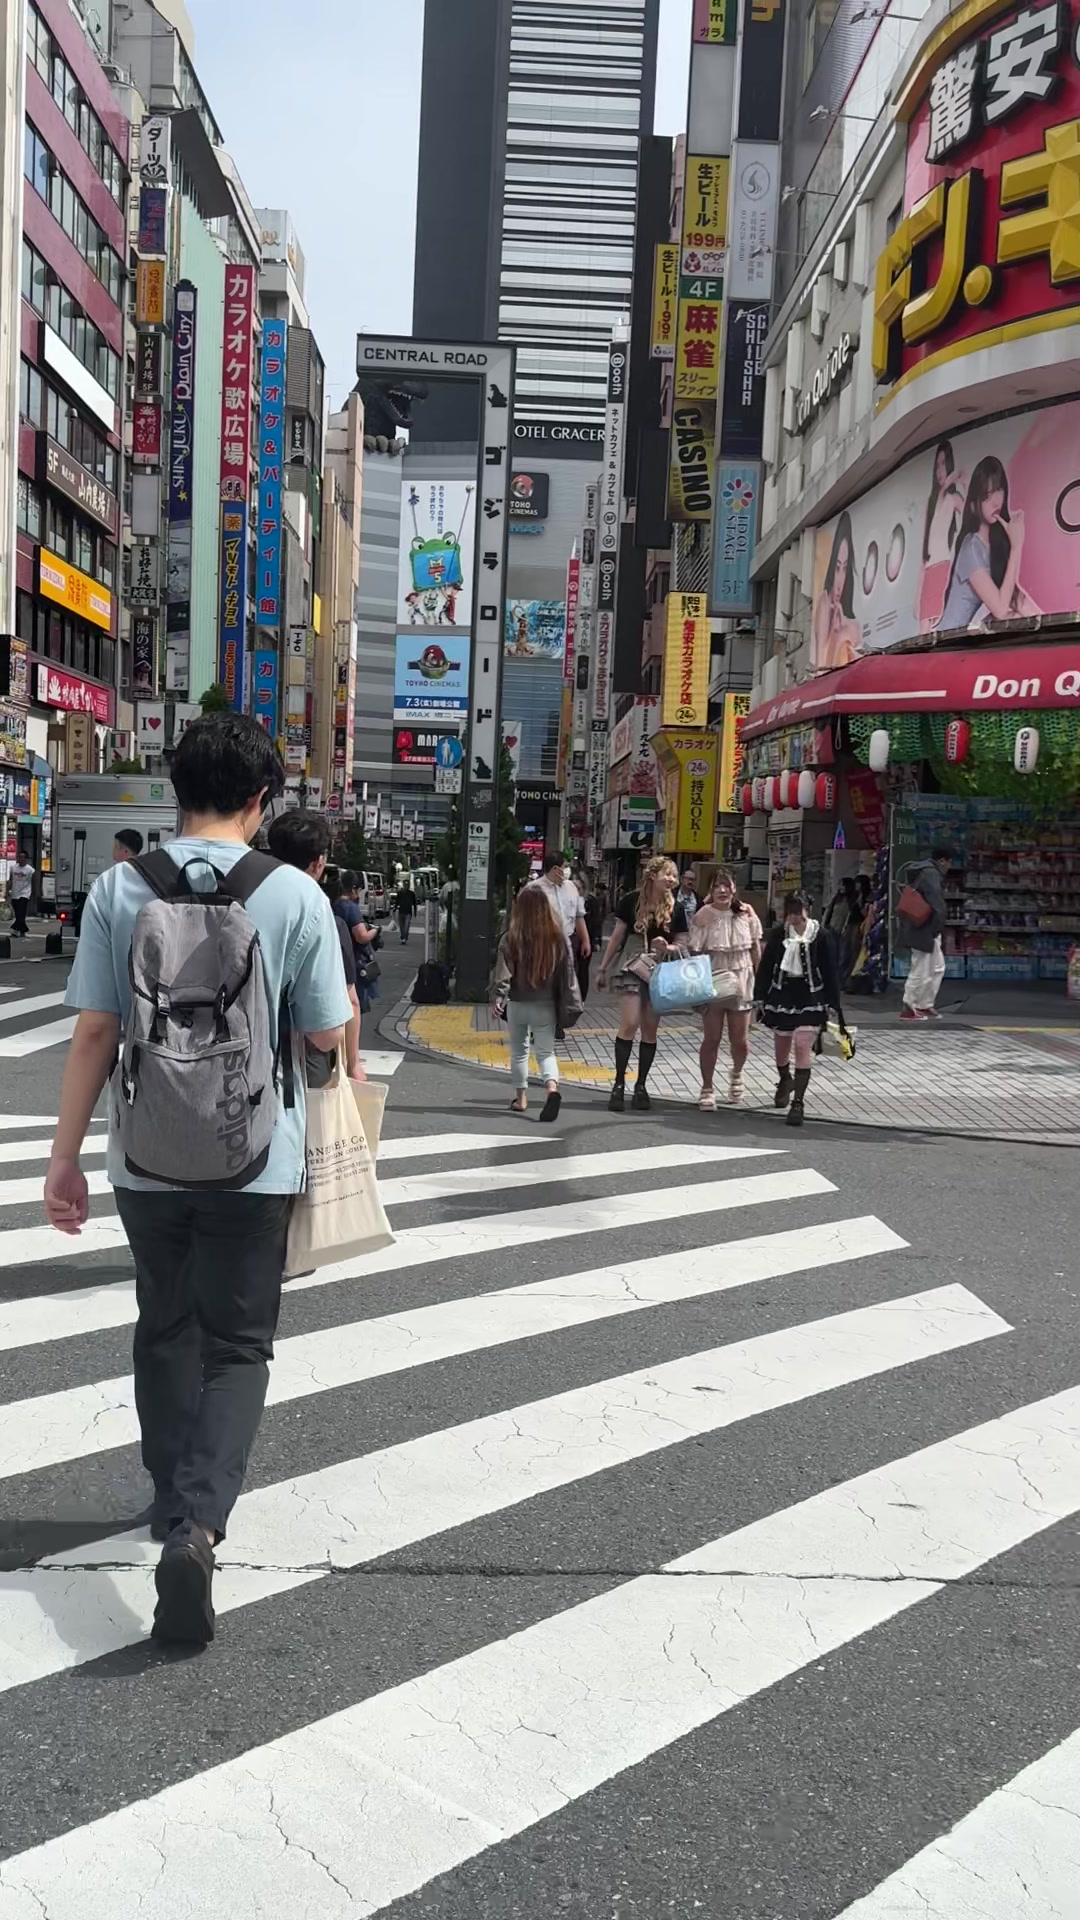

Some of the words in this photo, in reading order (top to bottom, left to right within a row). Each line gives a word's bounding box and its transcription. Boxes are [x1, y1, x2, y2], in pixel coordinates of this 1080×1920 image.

[147, 127, 163, 167] ダーツ
[696, 163, 713, 227] 生ビール
[686, 232, 726, 248] 199円
[661, 250, 674, 297] 生ビール
[689, 280, 717, 298] 4F
[683, 304, 719, 369] 麻雀
[223, 274, 248, 466] カラオケ歌広場
[364, 347, 439, 363] CENTRAL
[444, 352, 488, 366] ROAD
[610, 352, 625, 396] Booth
[677, 372, 709, 383] スリー
[608, 408, 620, 457] ネットカフェ
[172, 413, 190, 488] SHINJUKU
[608, 461, 617, 469] &
[674, 407, 712, 512] CASINO
[259, 330, 283, 614] カラオケ&パーティー館
[606, 472, 616, 506] カプセル
[508, 508, 538, 516] CINEMAS
[509, 500, 531, 508] TOHO
[226, 515, 241, 531] 薬
[434, 572, 442, 583] 5
[477, 446, 507, 724] ゴジラロード
[600, 558, 615, 601] Booth
[721, 580, 744, 595] 5F
[972, 674, 1041, 699] Don
[141, 717, 148, 731] I
[593, 721, 606, 730] 2F
[674, 739, 716, 750] カラオケ
[690, 779, 705, 842] 持込OK!
[216, 1052, 248, 1171] adidas
